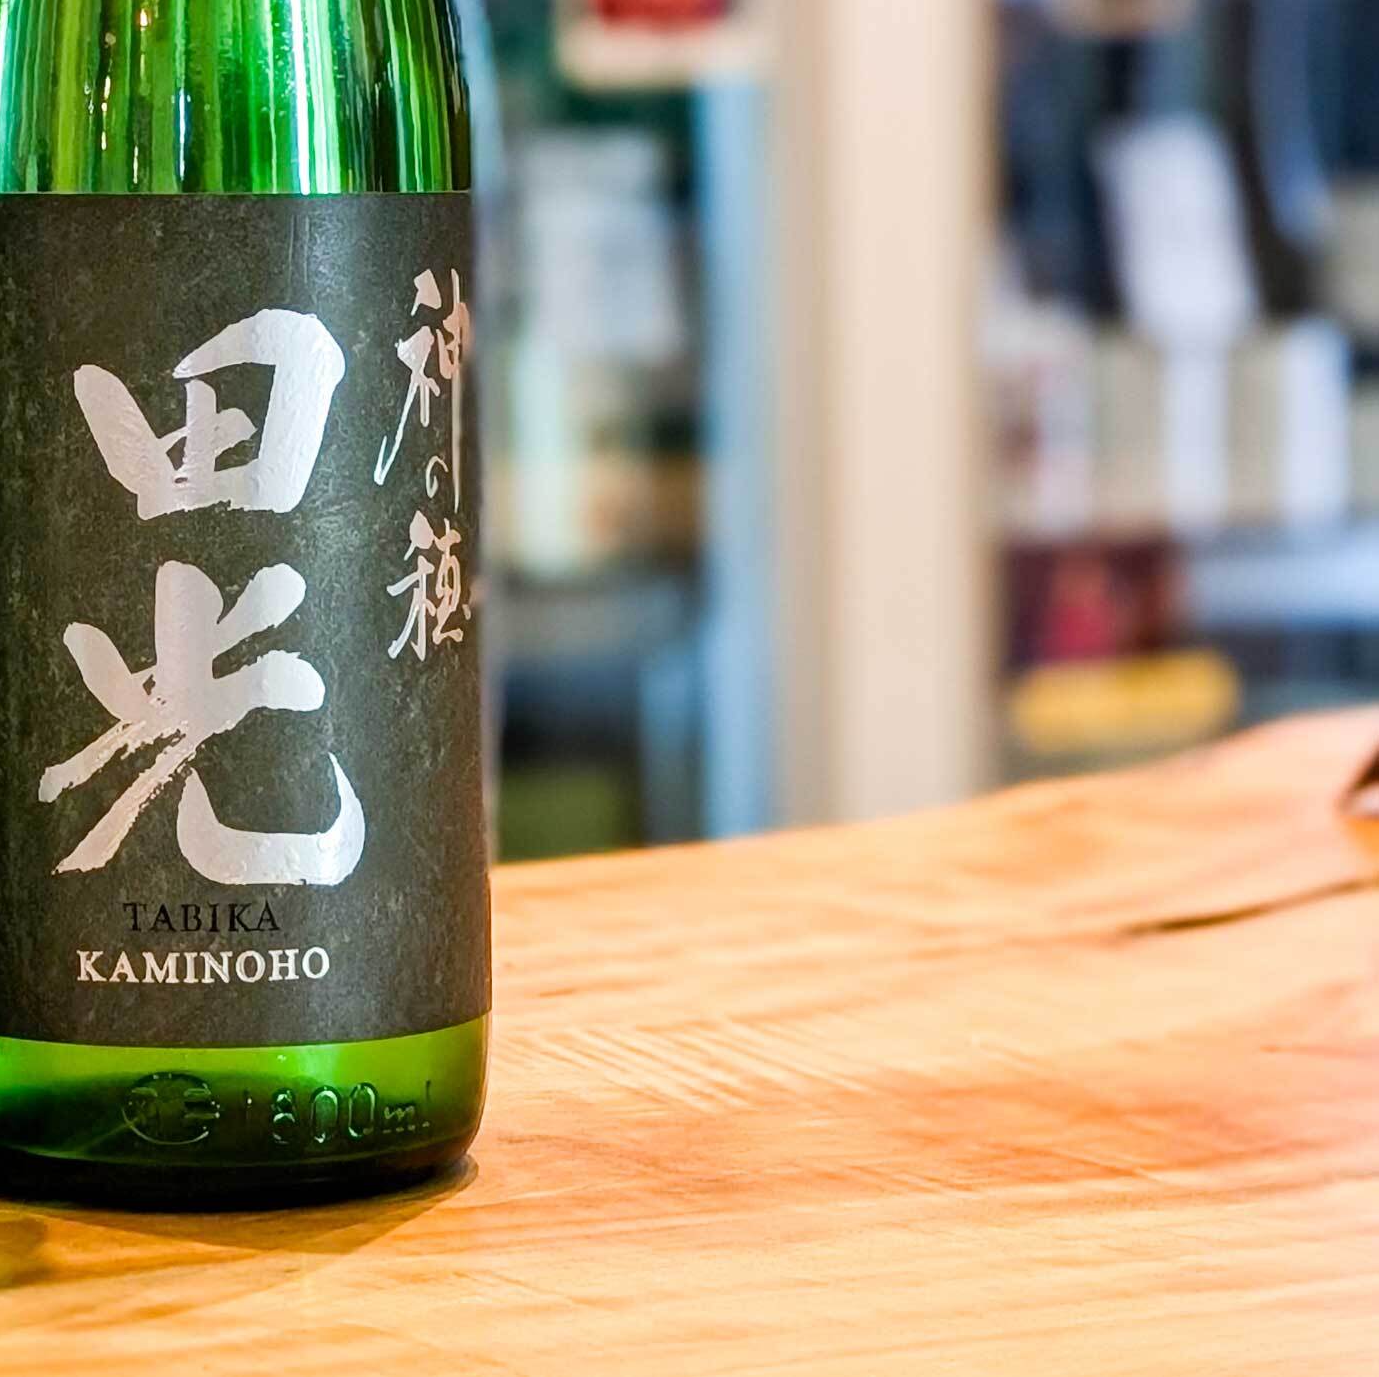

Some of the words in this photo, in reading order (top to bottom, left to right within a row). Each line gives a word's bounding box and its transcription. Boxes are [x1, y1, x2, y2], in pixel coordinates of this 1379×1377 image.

[38, 308, 366, 886] 田光
[122, 900, 282, 933] TABIKA
[76, 946, 331, 984] KAMINOHO
